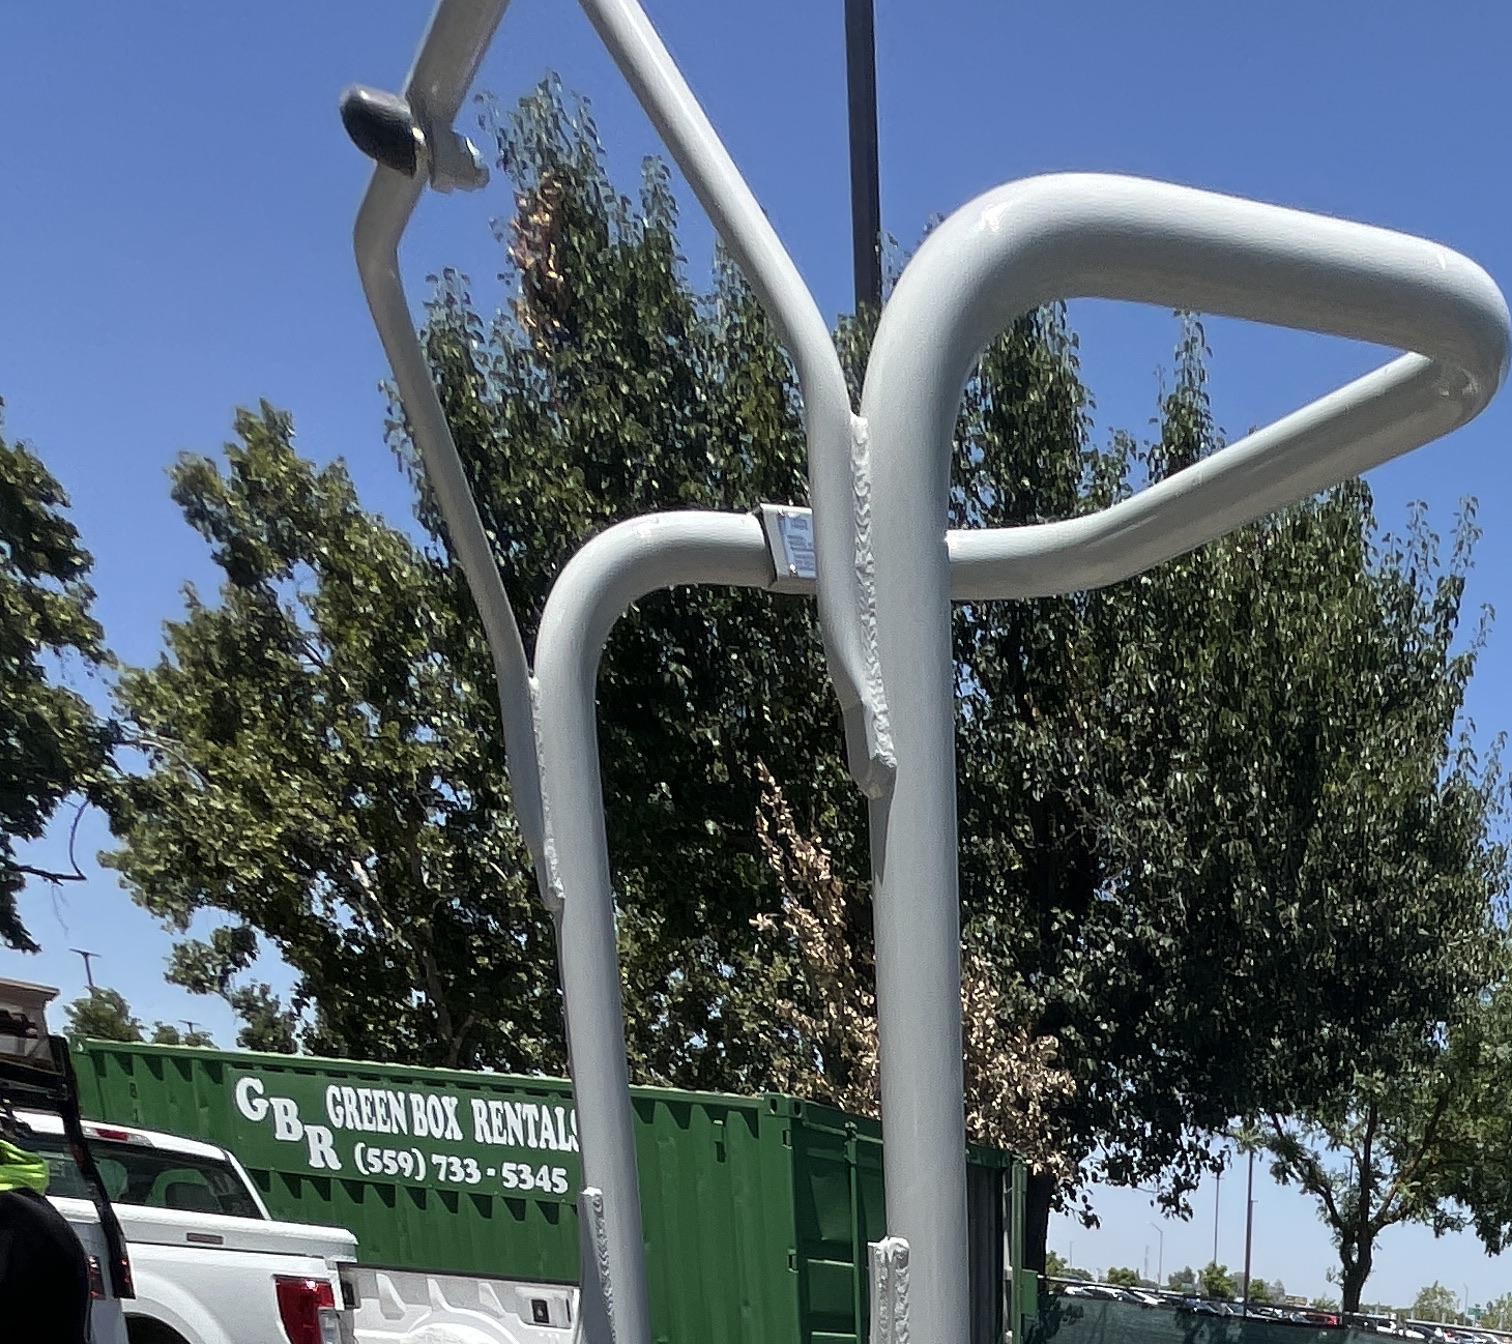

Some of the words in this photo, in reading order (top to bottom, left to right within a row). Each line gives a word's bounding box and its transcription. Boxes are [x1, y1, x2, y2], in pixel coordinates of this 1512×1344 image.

[326, 1084, 408, 1135] GREEN
[410, 1093, 464, 1141] BOX
[354, 1141, 427, 1181] (559)
